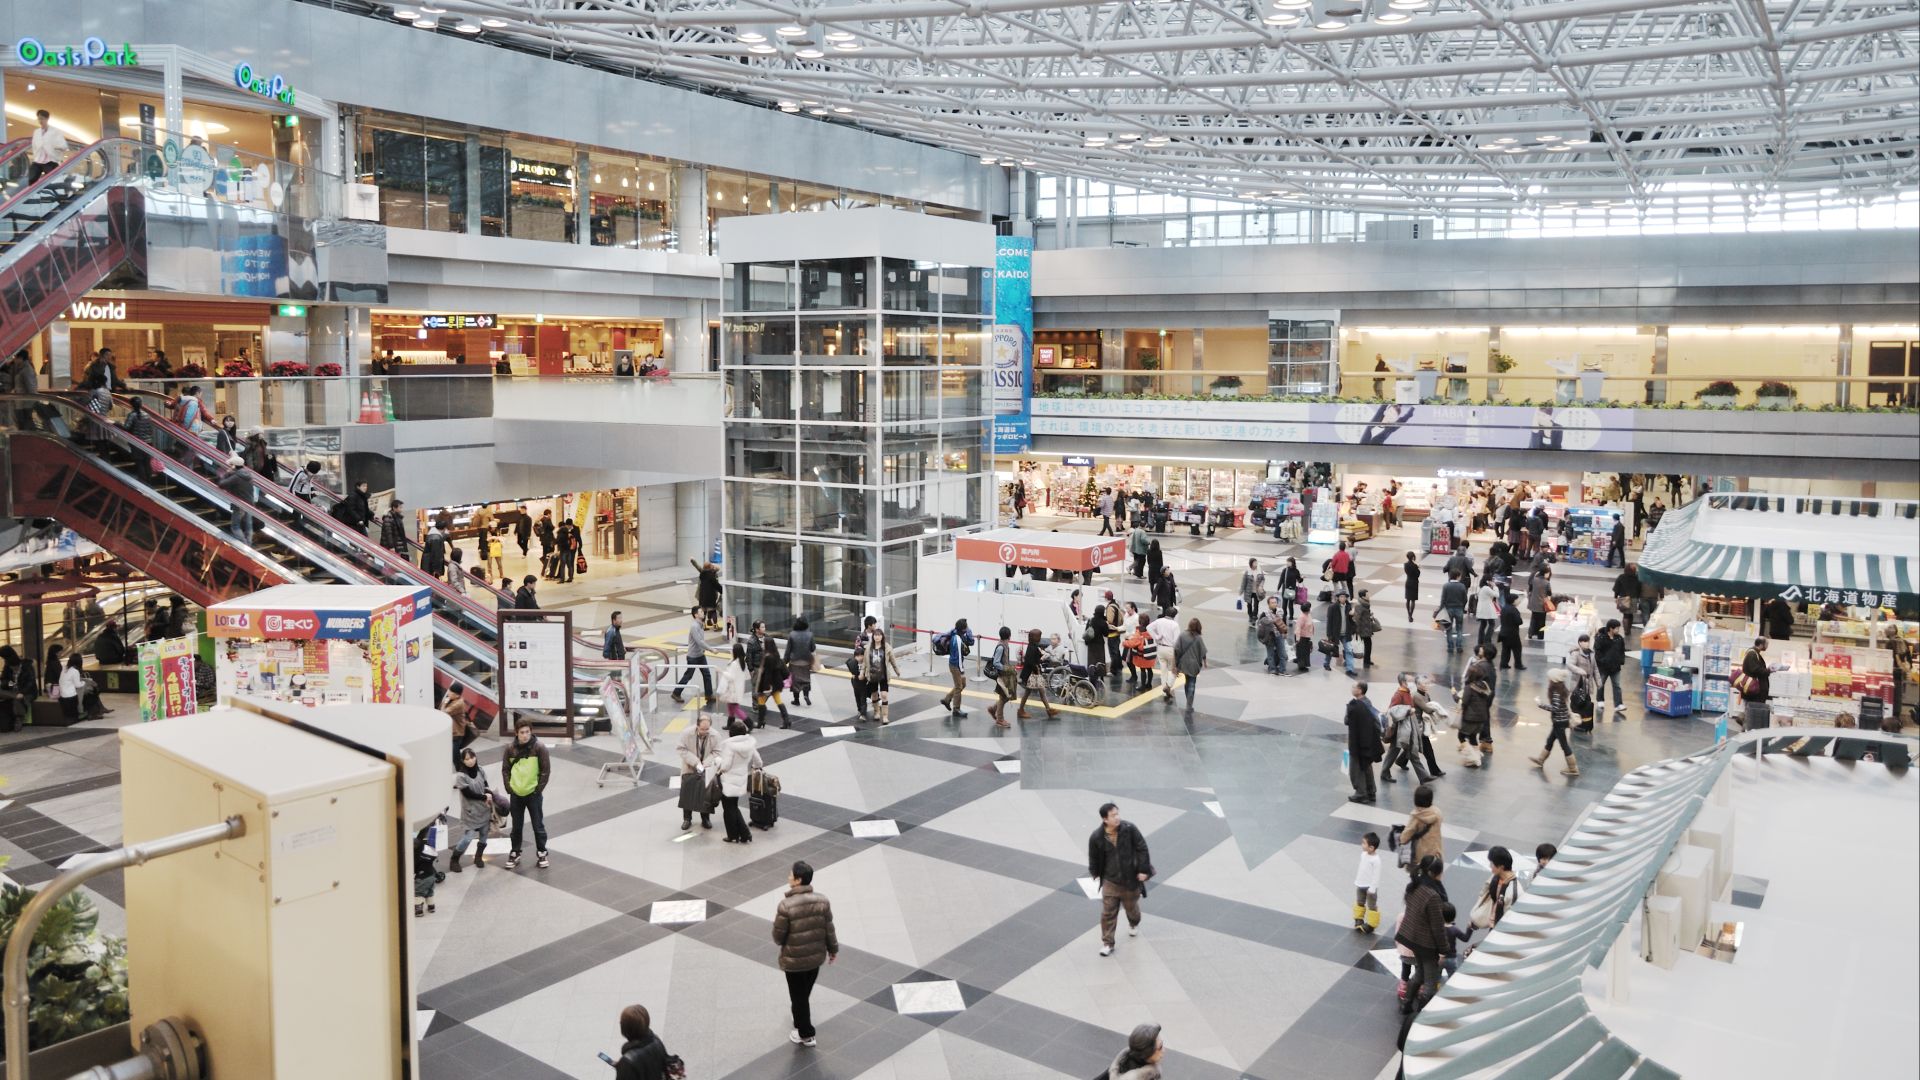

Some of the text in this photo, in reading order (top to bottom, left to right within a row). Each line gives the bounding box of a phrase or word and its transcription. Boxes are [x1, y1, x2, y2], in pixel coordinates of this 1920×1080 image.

[16, 37, 138, 66] Oasis Park
[235, 63, 295, 106] Oasis Park
[72, 302, 126, 319] World
[1805, 587, 1898, 608] 北海道物産
[238, 613, 248, 627] 6
[283, 618, 314, 630] 宝くじ
[325, 617, 366, 629] NUMBERS
